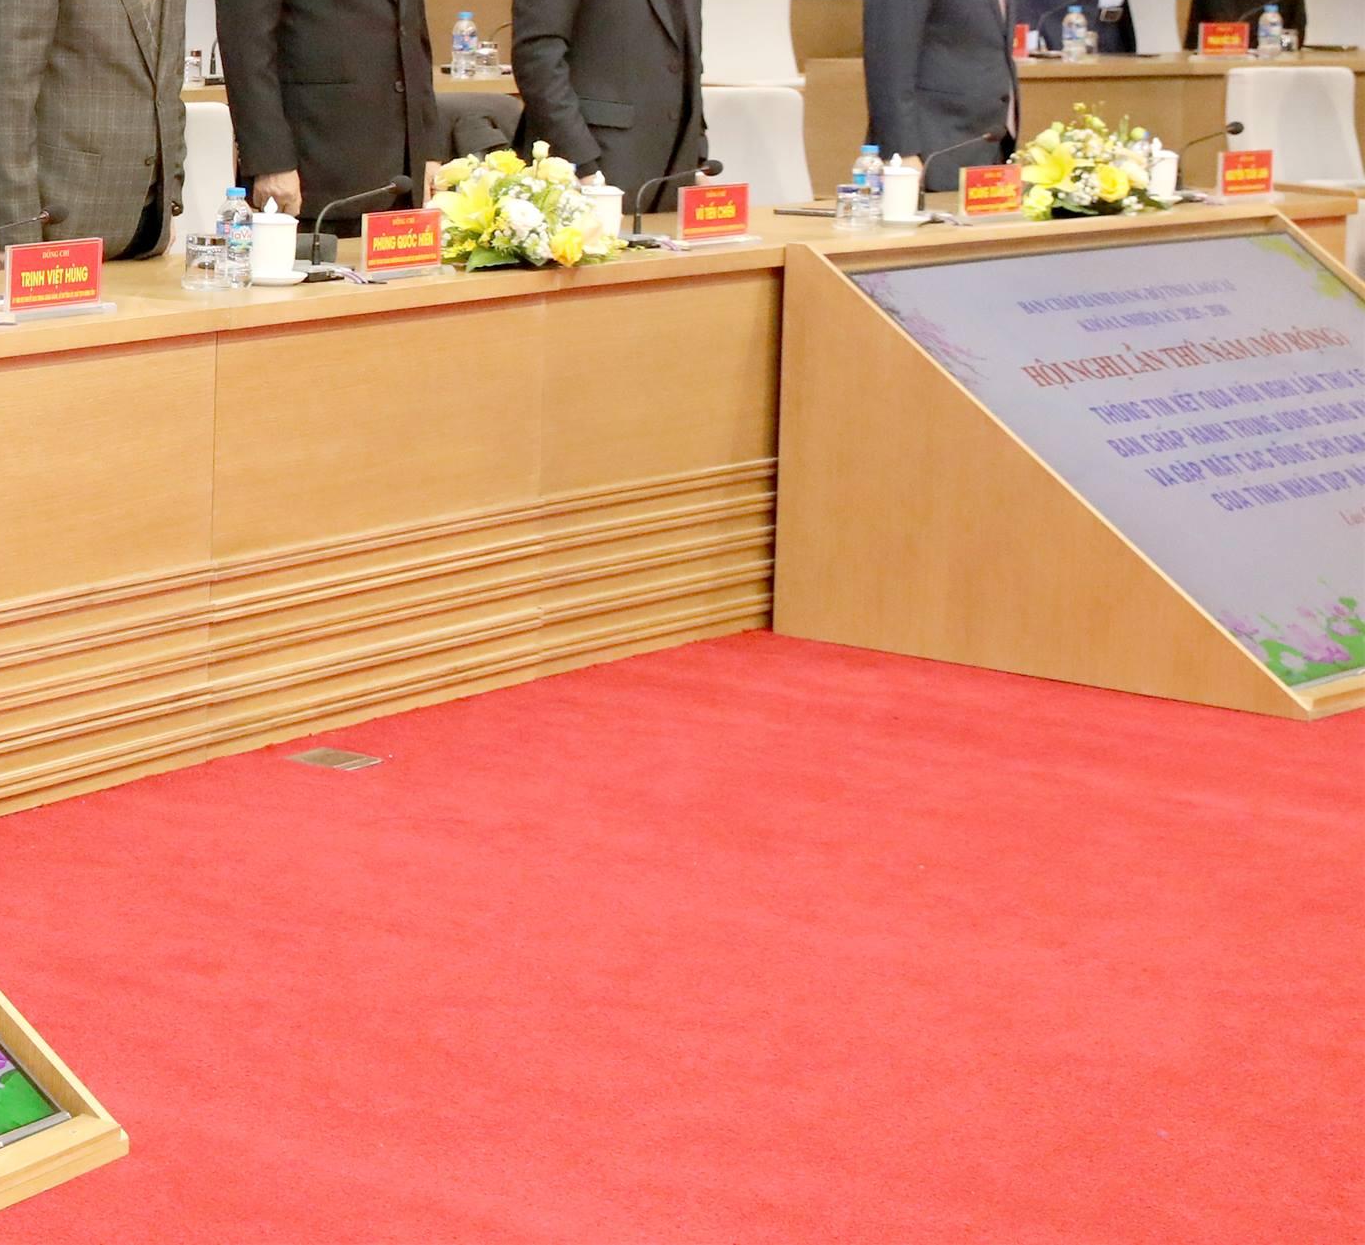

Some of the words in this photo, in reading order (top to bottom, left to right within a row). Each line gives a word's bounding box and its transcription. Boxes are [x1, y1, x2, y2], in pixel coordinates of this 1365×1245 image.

[21, 271, 45, 292] TRỊNH
[46, 265, 63, 289] VIỆT
[65, 263, 89, 284] HÙNG
